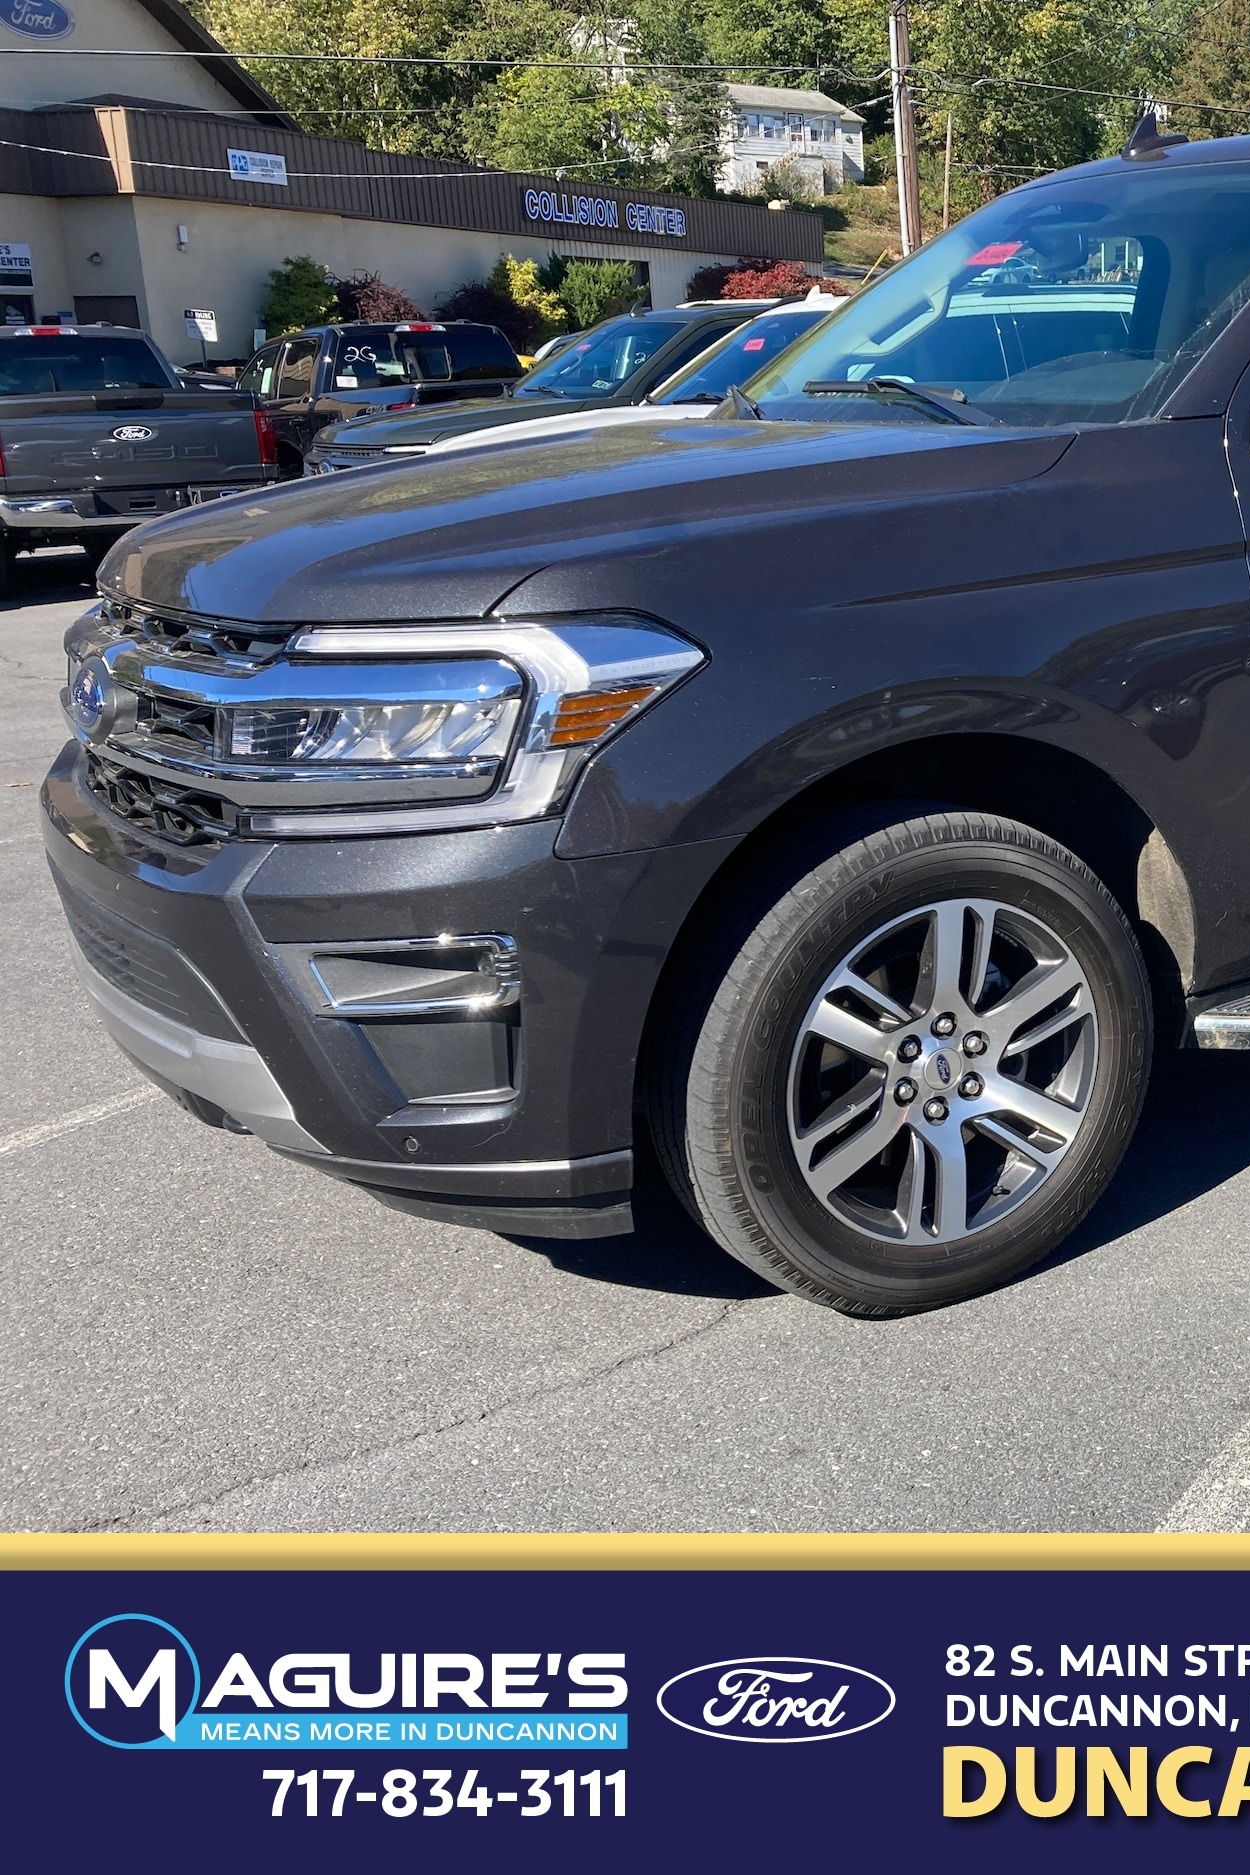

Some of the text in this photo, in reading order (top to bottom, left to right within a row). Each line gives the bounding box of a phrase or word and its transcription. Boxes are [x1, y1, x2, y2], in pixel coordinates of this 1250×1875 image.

[12, 0, 56, 30] Ford
[525, 189, 686, 236] COLLISION CENTER
[120, 428, 145, 439] Ford
[741, 870, 895, 1194] OPEN COUNTRY
[1114, 996, 1145, 1141] TOYO
